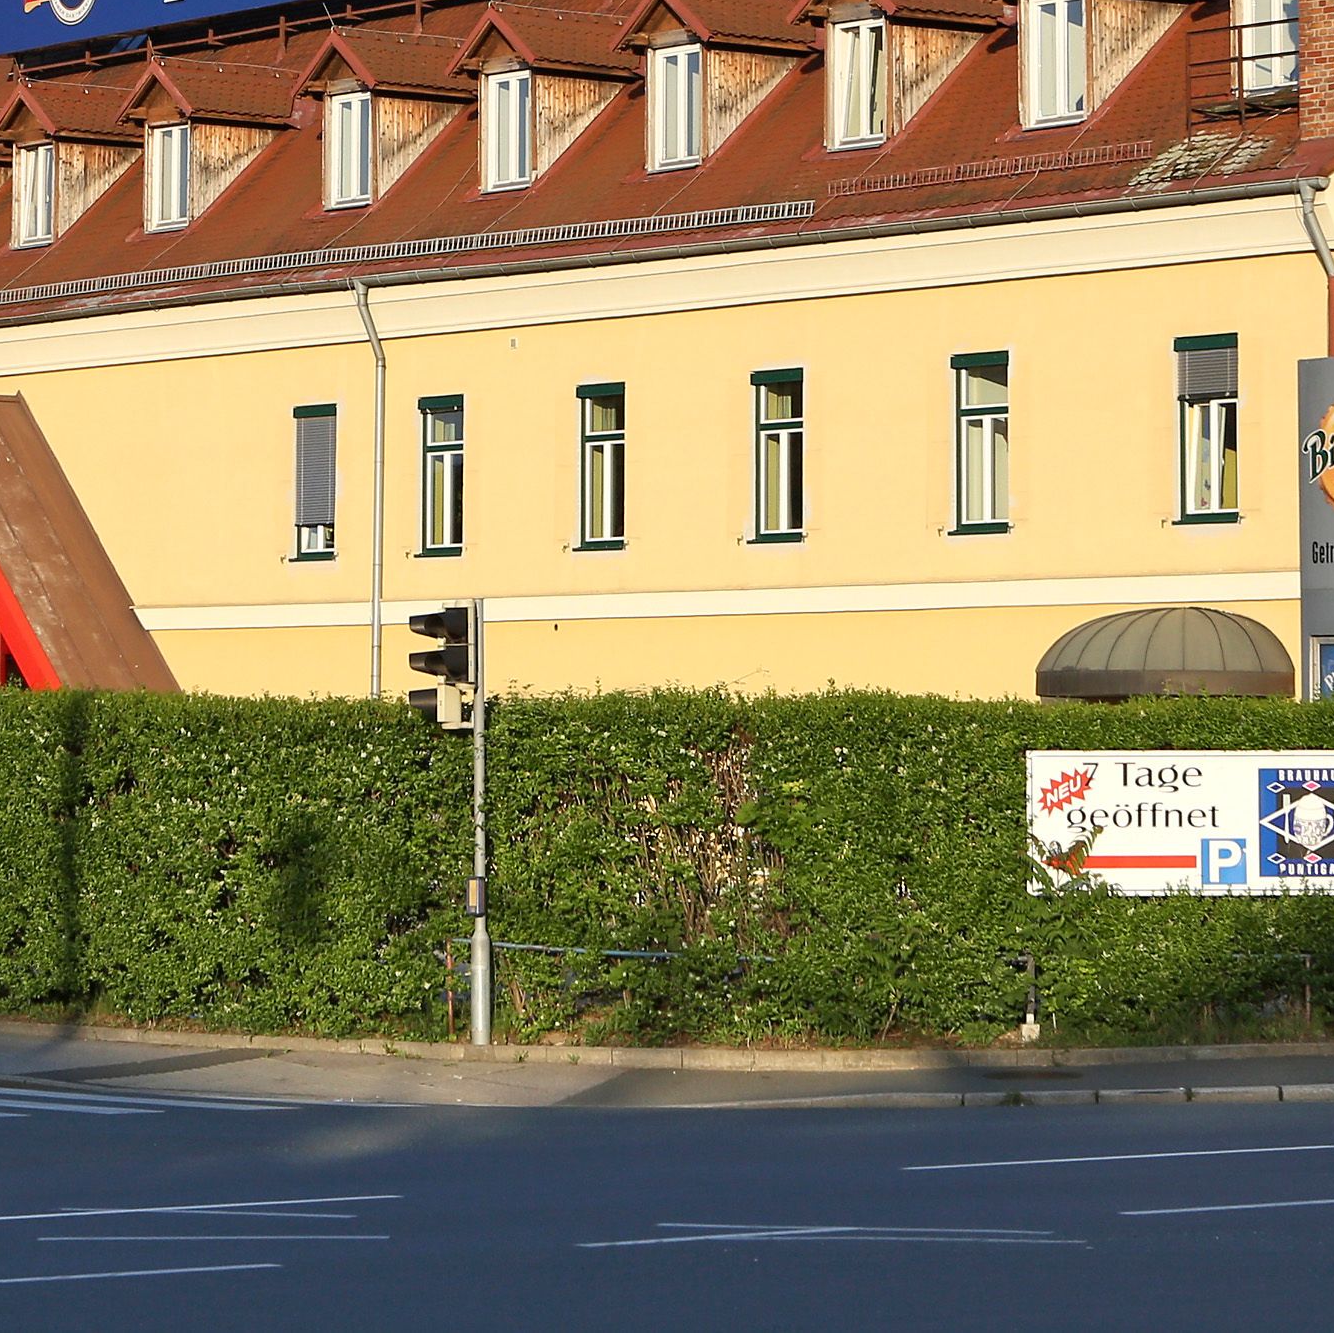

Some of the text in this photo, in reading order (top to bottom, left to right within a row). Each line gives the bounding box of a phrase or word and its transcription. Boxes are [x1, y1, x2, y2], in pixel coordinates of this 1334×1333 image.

[1045, 775, 1082, 807] NEU
[1082, 762, 1203, 793] 7 Tage
[1066, 802, 1219, 833] geöffnet
